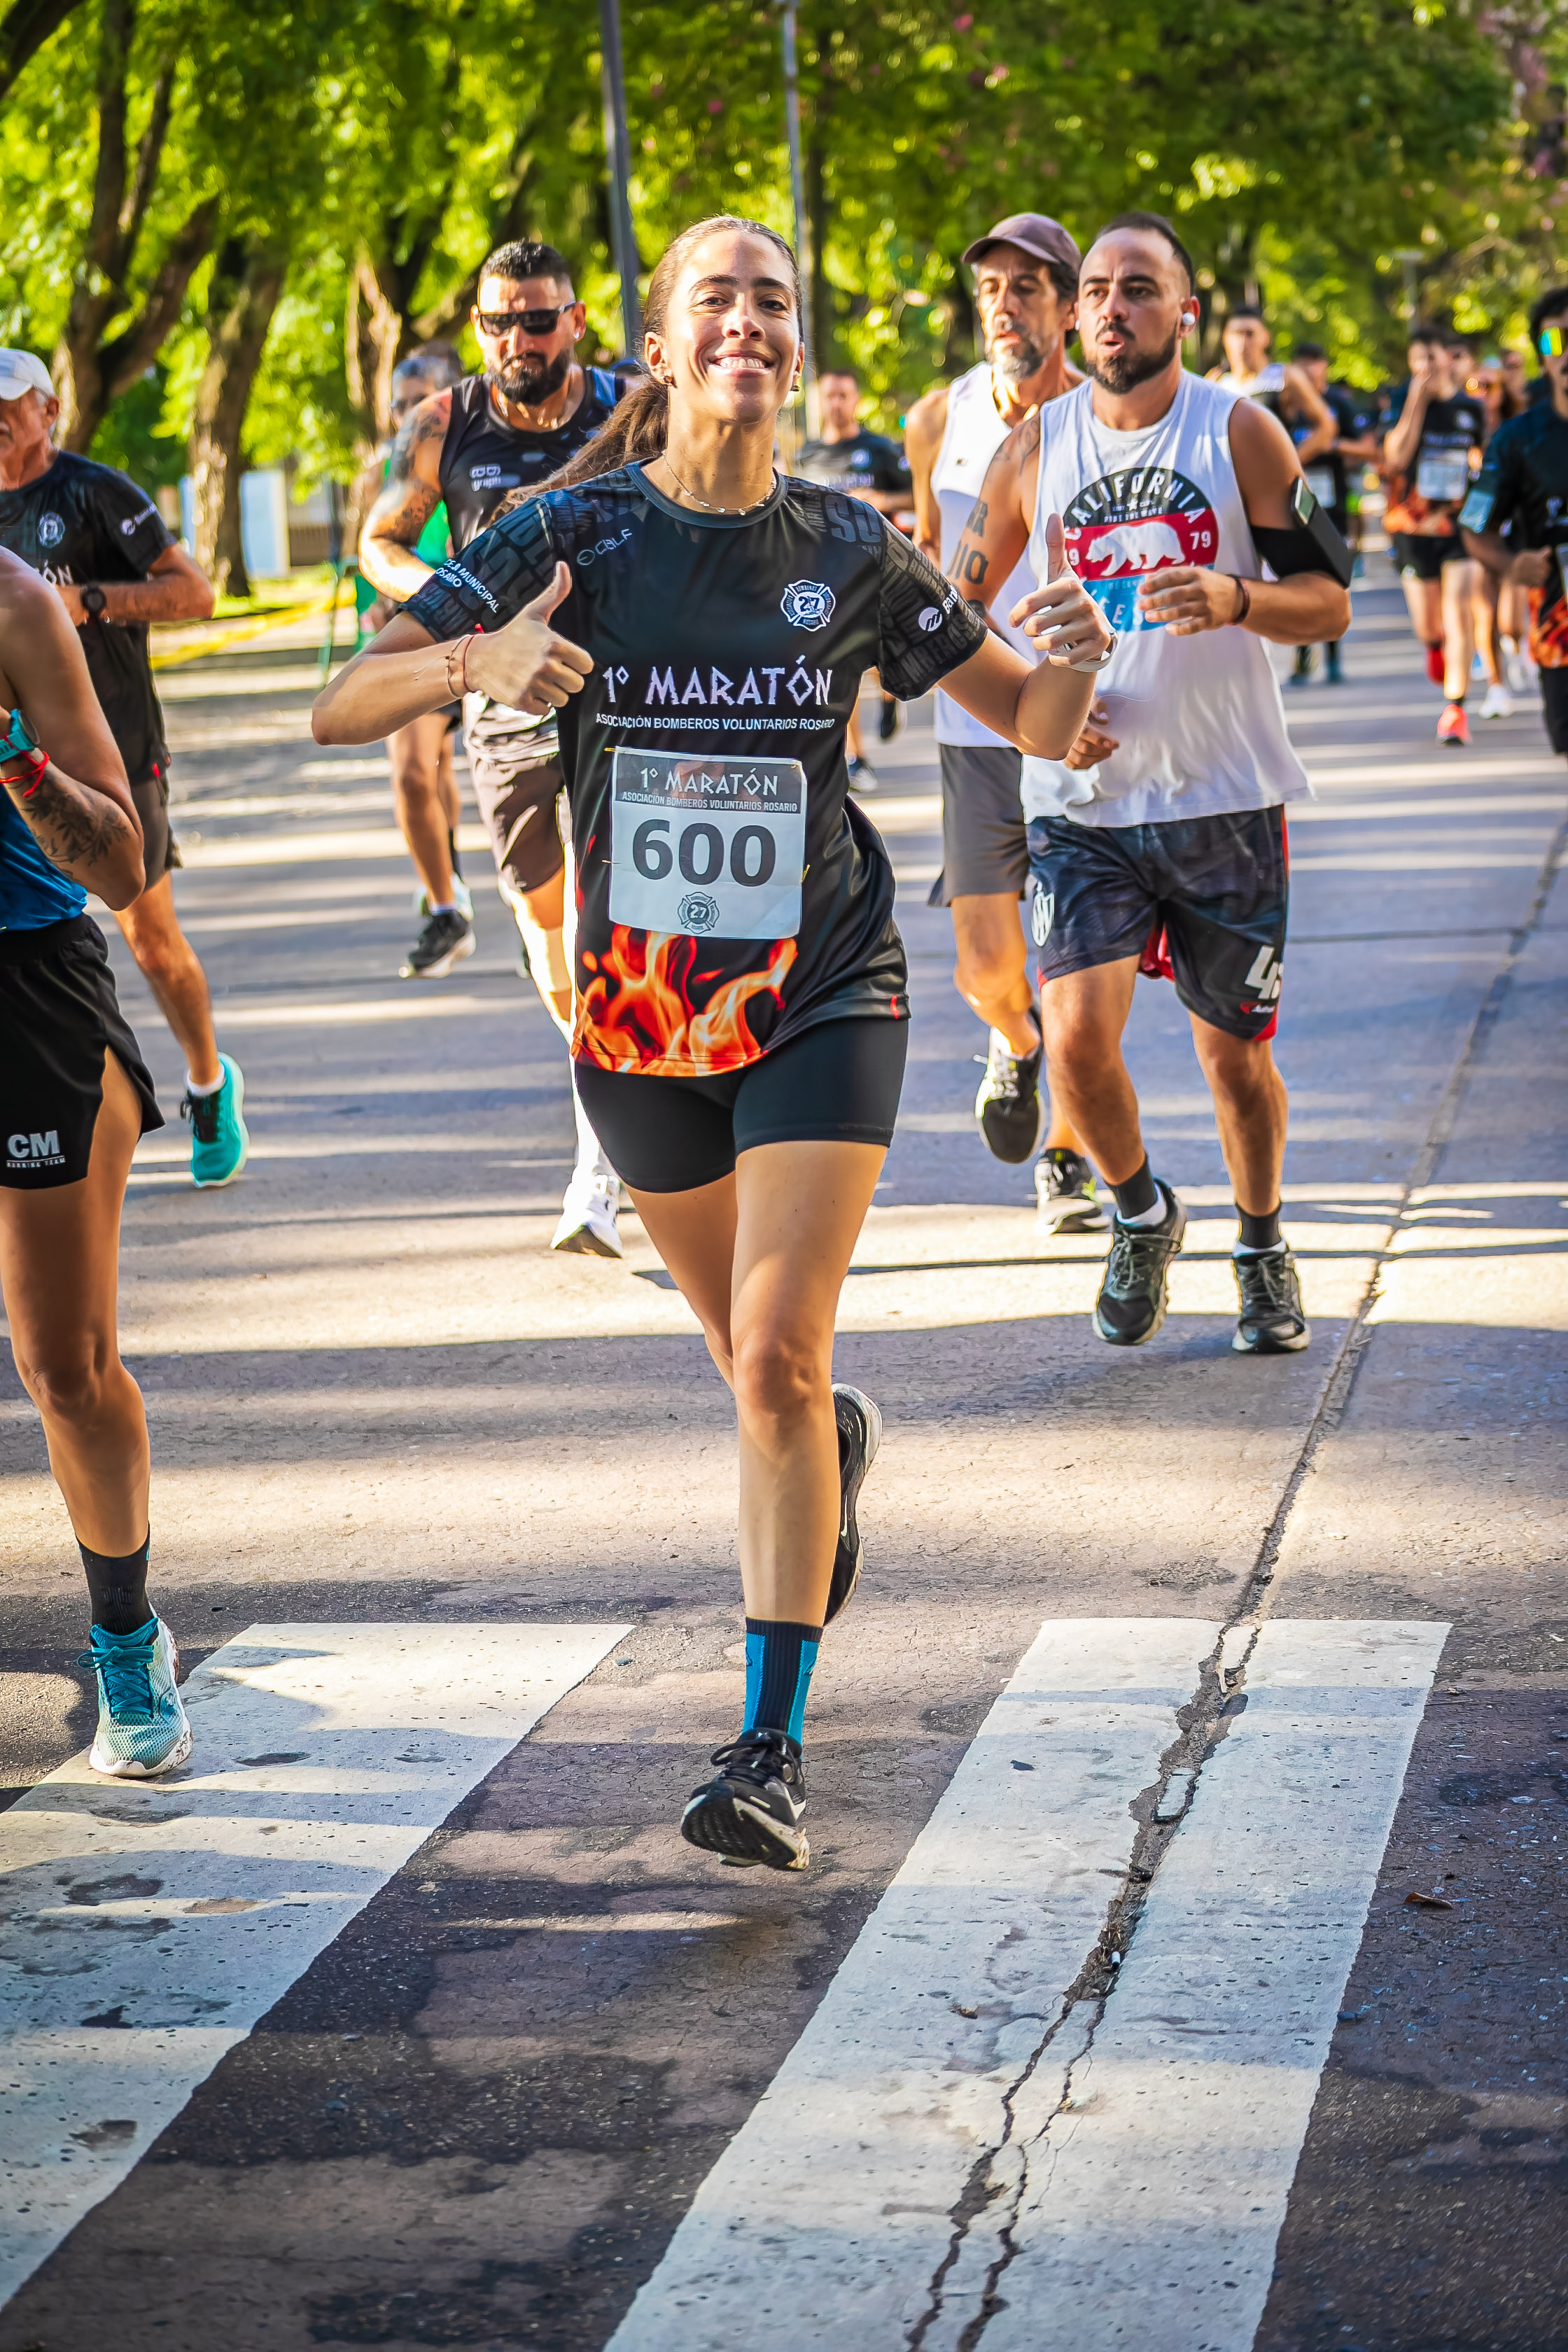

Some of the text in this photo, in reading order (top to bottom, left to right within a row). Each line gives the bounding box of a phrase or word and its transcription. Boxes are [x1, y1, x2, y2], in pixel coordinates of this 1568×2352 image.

[1064, 472, 1205, 540] CALIFORNIA
[1190, 531, 1211, 550] 79
[458, 568, 500, 614] MUNICIPAL
[798, 596, 820, 612] 27
[645, 654, 833, 706] MARATÓN
[595, 713, 652, 728] ASOCIACIÓN
[654, 718, 720, 729] BOMBEROS
[722, 718, 797, 730] VOLUNTARIOS
[664, 767, 778, 797] MARATÓN
[666, 797, 708, 808] BOMBEROS
[710, 799, 762, 811] VOLUNTARIOS
[764, 802, 798, 813] ROSARIO
[633, 818, 776, 887] 600
[690, 904, 707, 918] 27
[8, 1130, 60, 1158] CM
